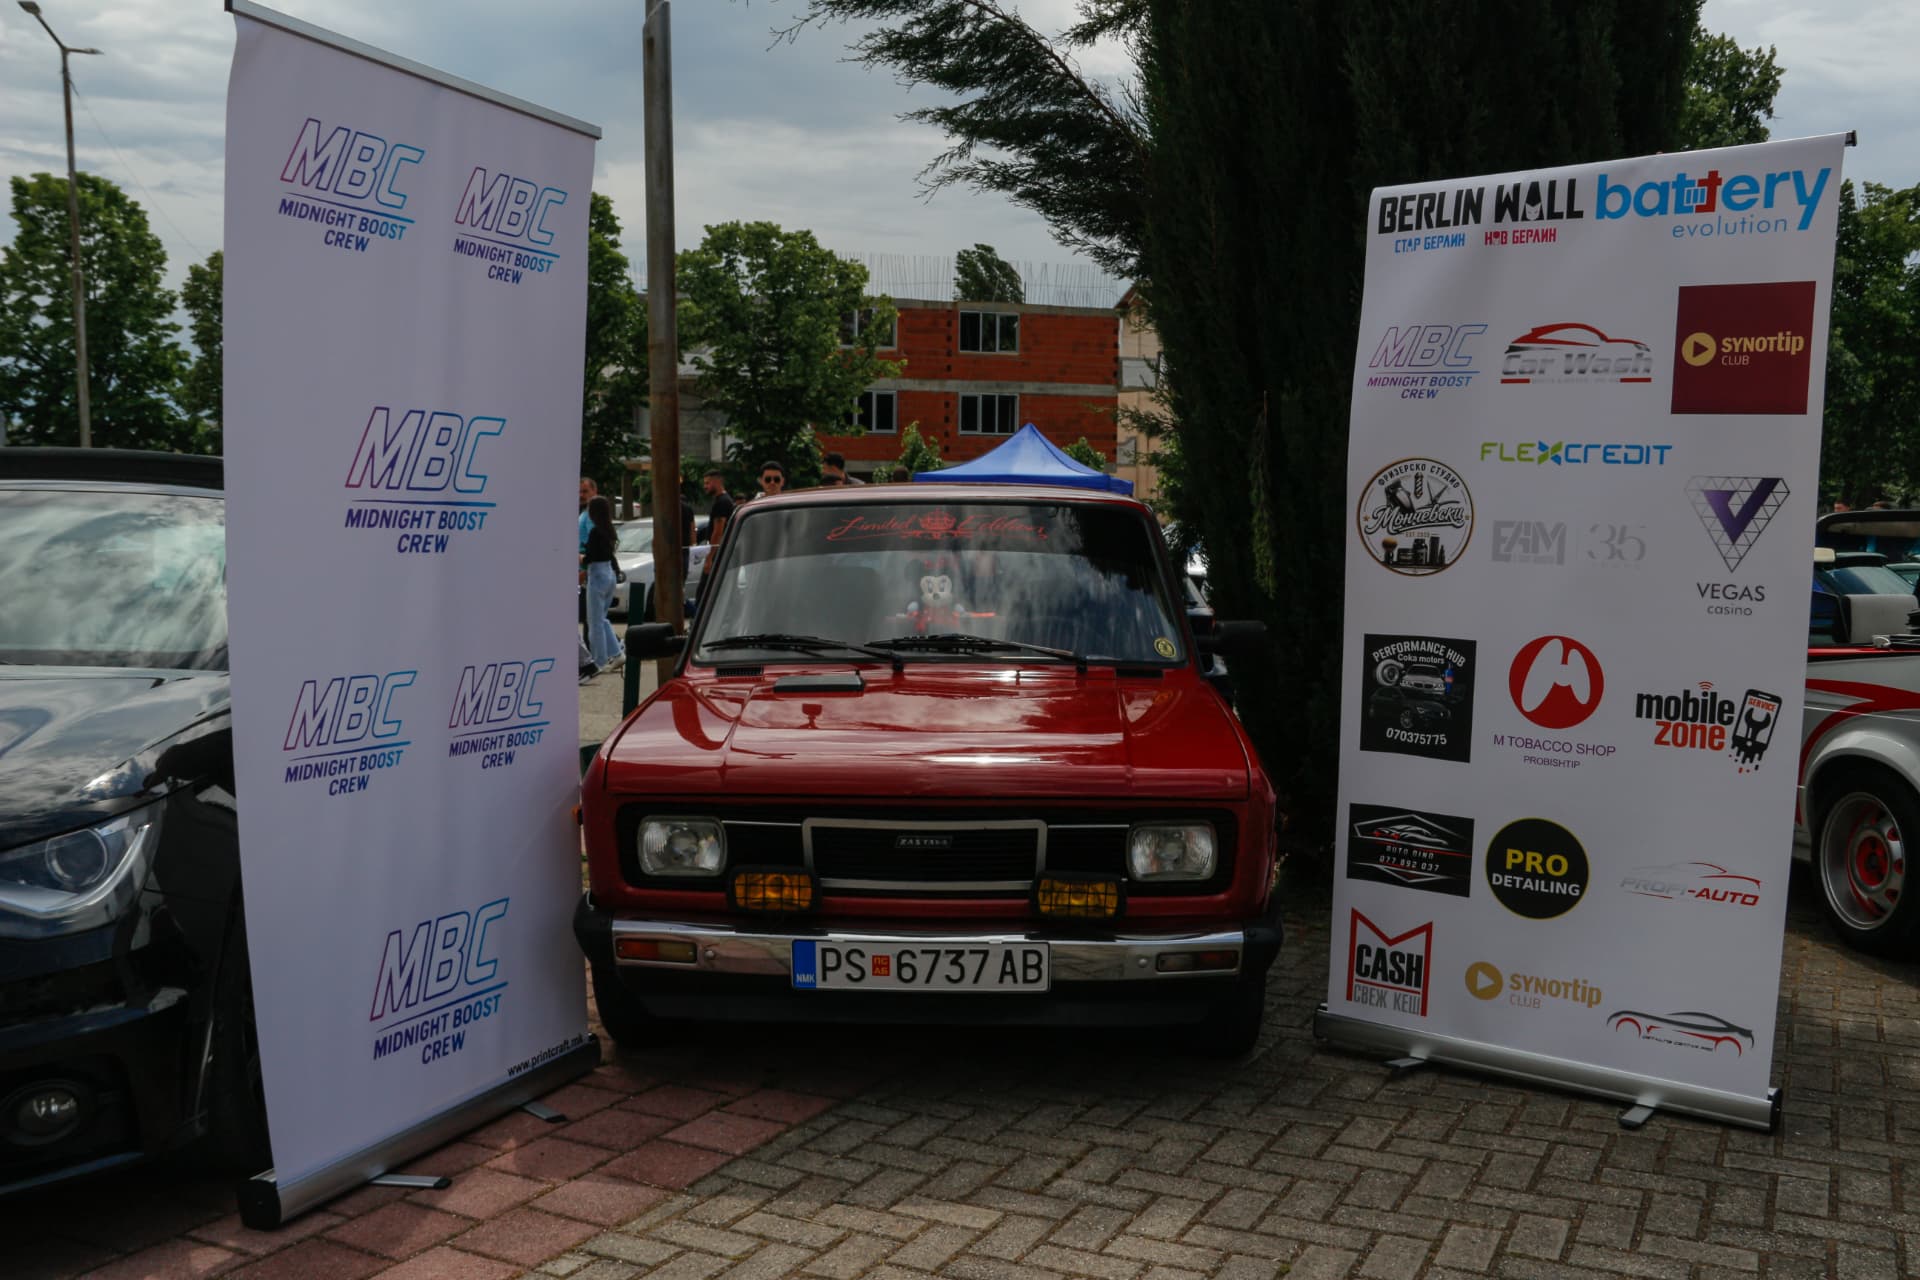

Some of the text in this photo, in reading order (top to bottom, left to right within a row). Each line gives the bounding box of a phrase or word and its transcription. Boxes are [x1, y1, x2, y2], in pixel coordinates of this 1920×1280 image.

[280, 117, 425, 209] MBC
[454, 166, 568, 246] MBC
[1378, 178, 1584, 234] BERLIN WALL
[1595, 167, 1832, 231] battery
[278, 198, 407, 240] MIDNIGHT BOOST
[1672, 213, 1788, 239] evolution
[323, 228, 370, 252] CREW
[1423, 232, 1466, 250] БЕРЛИН
[1512, 228, 1557, 245] БЕРЛИН
[453, 238, 554, 273] MIDNIGHT BOOST
[487, 265, 524, 285] CREW
[1368, 324, 1488, 368] MBC
[1502, 352, 1653, 375] Car Wash
[1721, 355, 1750, 366] CLUB
[1367, 375, 1472, 388] MIDNIGHT BOOST
[1400, 388, 1440, 400] CREW
[345, 406, 506, 494] MBC
[1378, 463, 1461, 489] ФРИЗЕРСКО СТУДИО
[345, 508, 488, 530] MIDNIGHT BOOST
[397, 533, 449, 553] CREW
[1587, 521, 1647, 562] 35
[1696, 582, 1766, 603] VEGAS
[1707, 603, 1753, 617] casino
[1372, 640, 1467, 668] PERFORMANCE HUB
[1397, 653, 1445, 665] Coka motors
[448, 658, 555, 729] MBC
[283, 670, 418, 751] MBC
[1635, 689, 1735, 726] mobile
[449, 729, 544, 758] MIDNIGHT BOOST
[1385, 727, 1448, 745] 070375775
[1493, 734, 1617, 758] M TOBACCO SHOP
[1654, 720, 1726, 751] zone
[284, 750, 404, 784] MIDNIGHT BOOST
[481, 750, 516, 770] CREW
[1523, 755, 1581, 769] PROBISHTIP
[329, 774, 371, 797] CREW
[1379, 855, 1397, 865] 077
[1420, 862, 1440, 872] 037
[1505, 848, 1569, 877] PRO
[1491, 872, 1581, 897] DETAILING
[370, 897, 510, 1021] MBC
[821, 947, 1043, 984] PS 6737 AB
[1355, 943, 1424, 988] CASH
[796, 974, 816, 984] NMK
[1353, 983, 1421, 1015] СВЕЖ КЕШ
[1509, 993, 1541, 1009] CLUB
[373, 993, 503, 1061] MIDNIGHT BOOST
[421, 1030, 466, 1065] CREW
[507, 1033, 584, 1077] www.printcraft.mk
